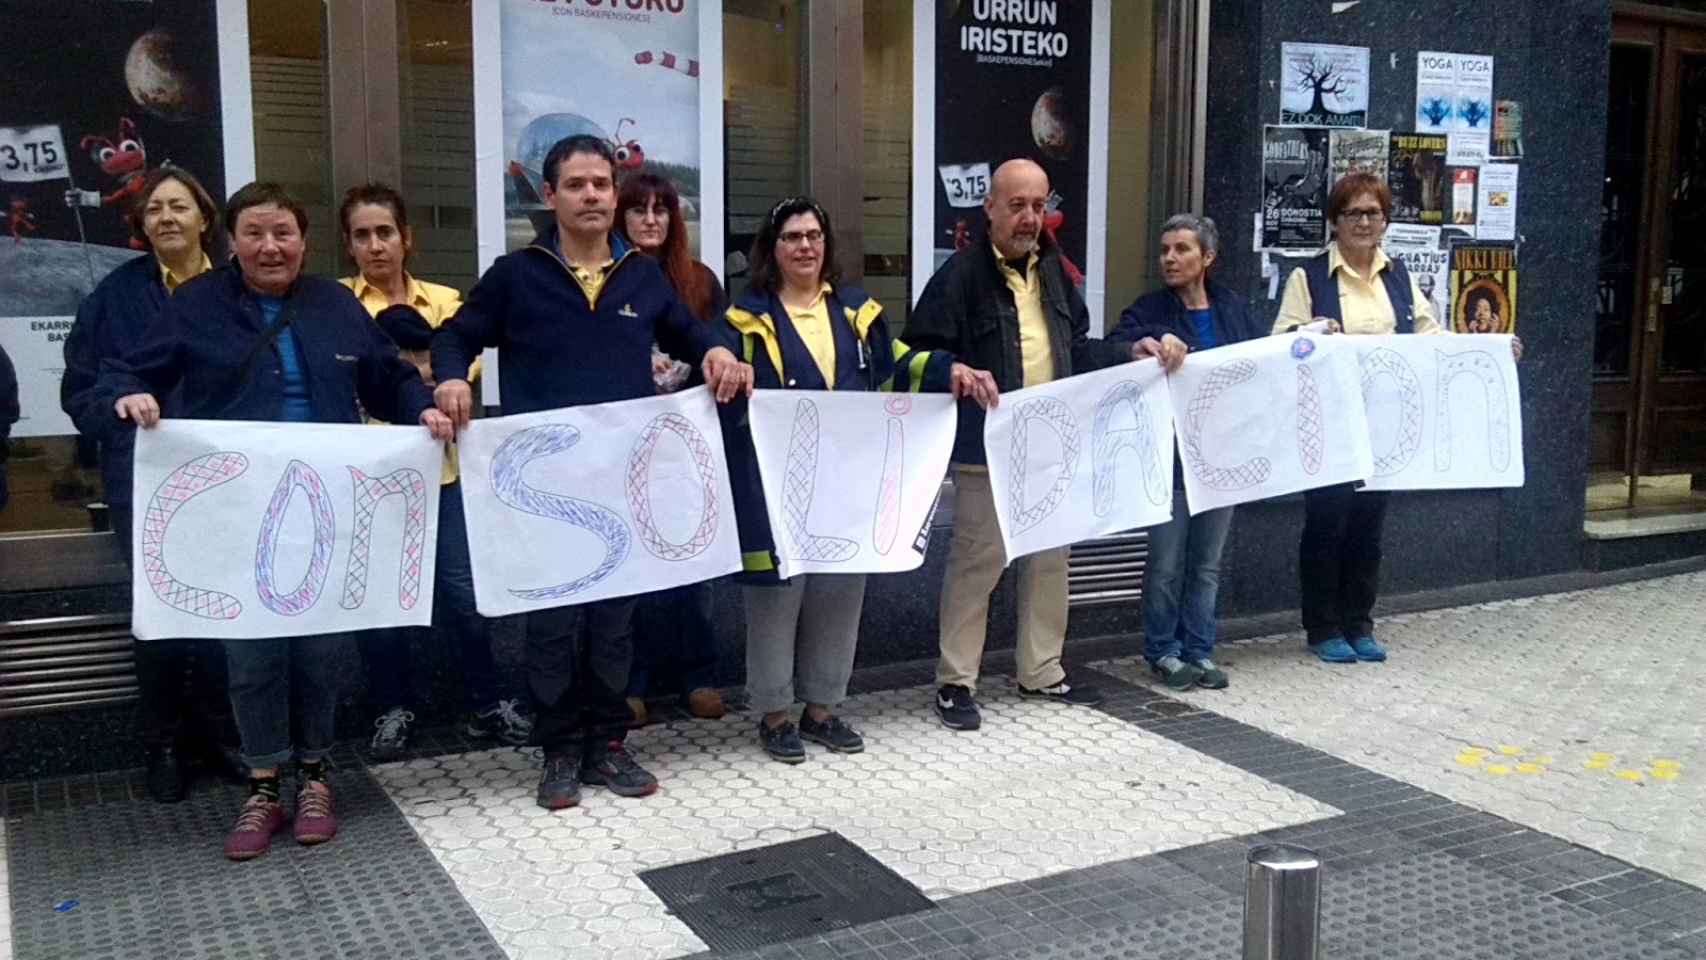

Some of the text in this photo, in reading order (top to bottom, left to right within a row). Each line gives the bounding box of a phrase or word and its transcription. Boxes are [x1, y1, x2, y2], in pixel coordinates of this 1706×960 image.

[973, 0, 1058, 26] URRUN
[960, 25, 1068, 58] IRISTEKO
[1422, 57, 1453, 70] YOGA
[1461, 60, 1489, 73] YOGA
[1266, 208, 1280, 220] 26
[1281, 208, 1323, 218] DONOSTIA
[1407, 263, 1441, 274] ARRAY
[31, 321, 72, 331] EKARR
